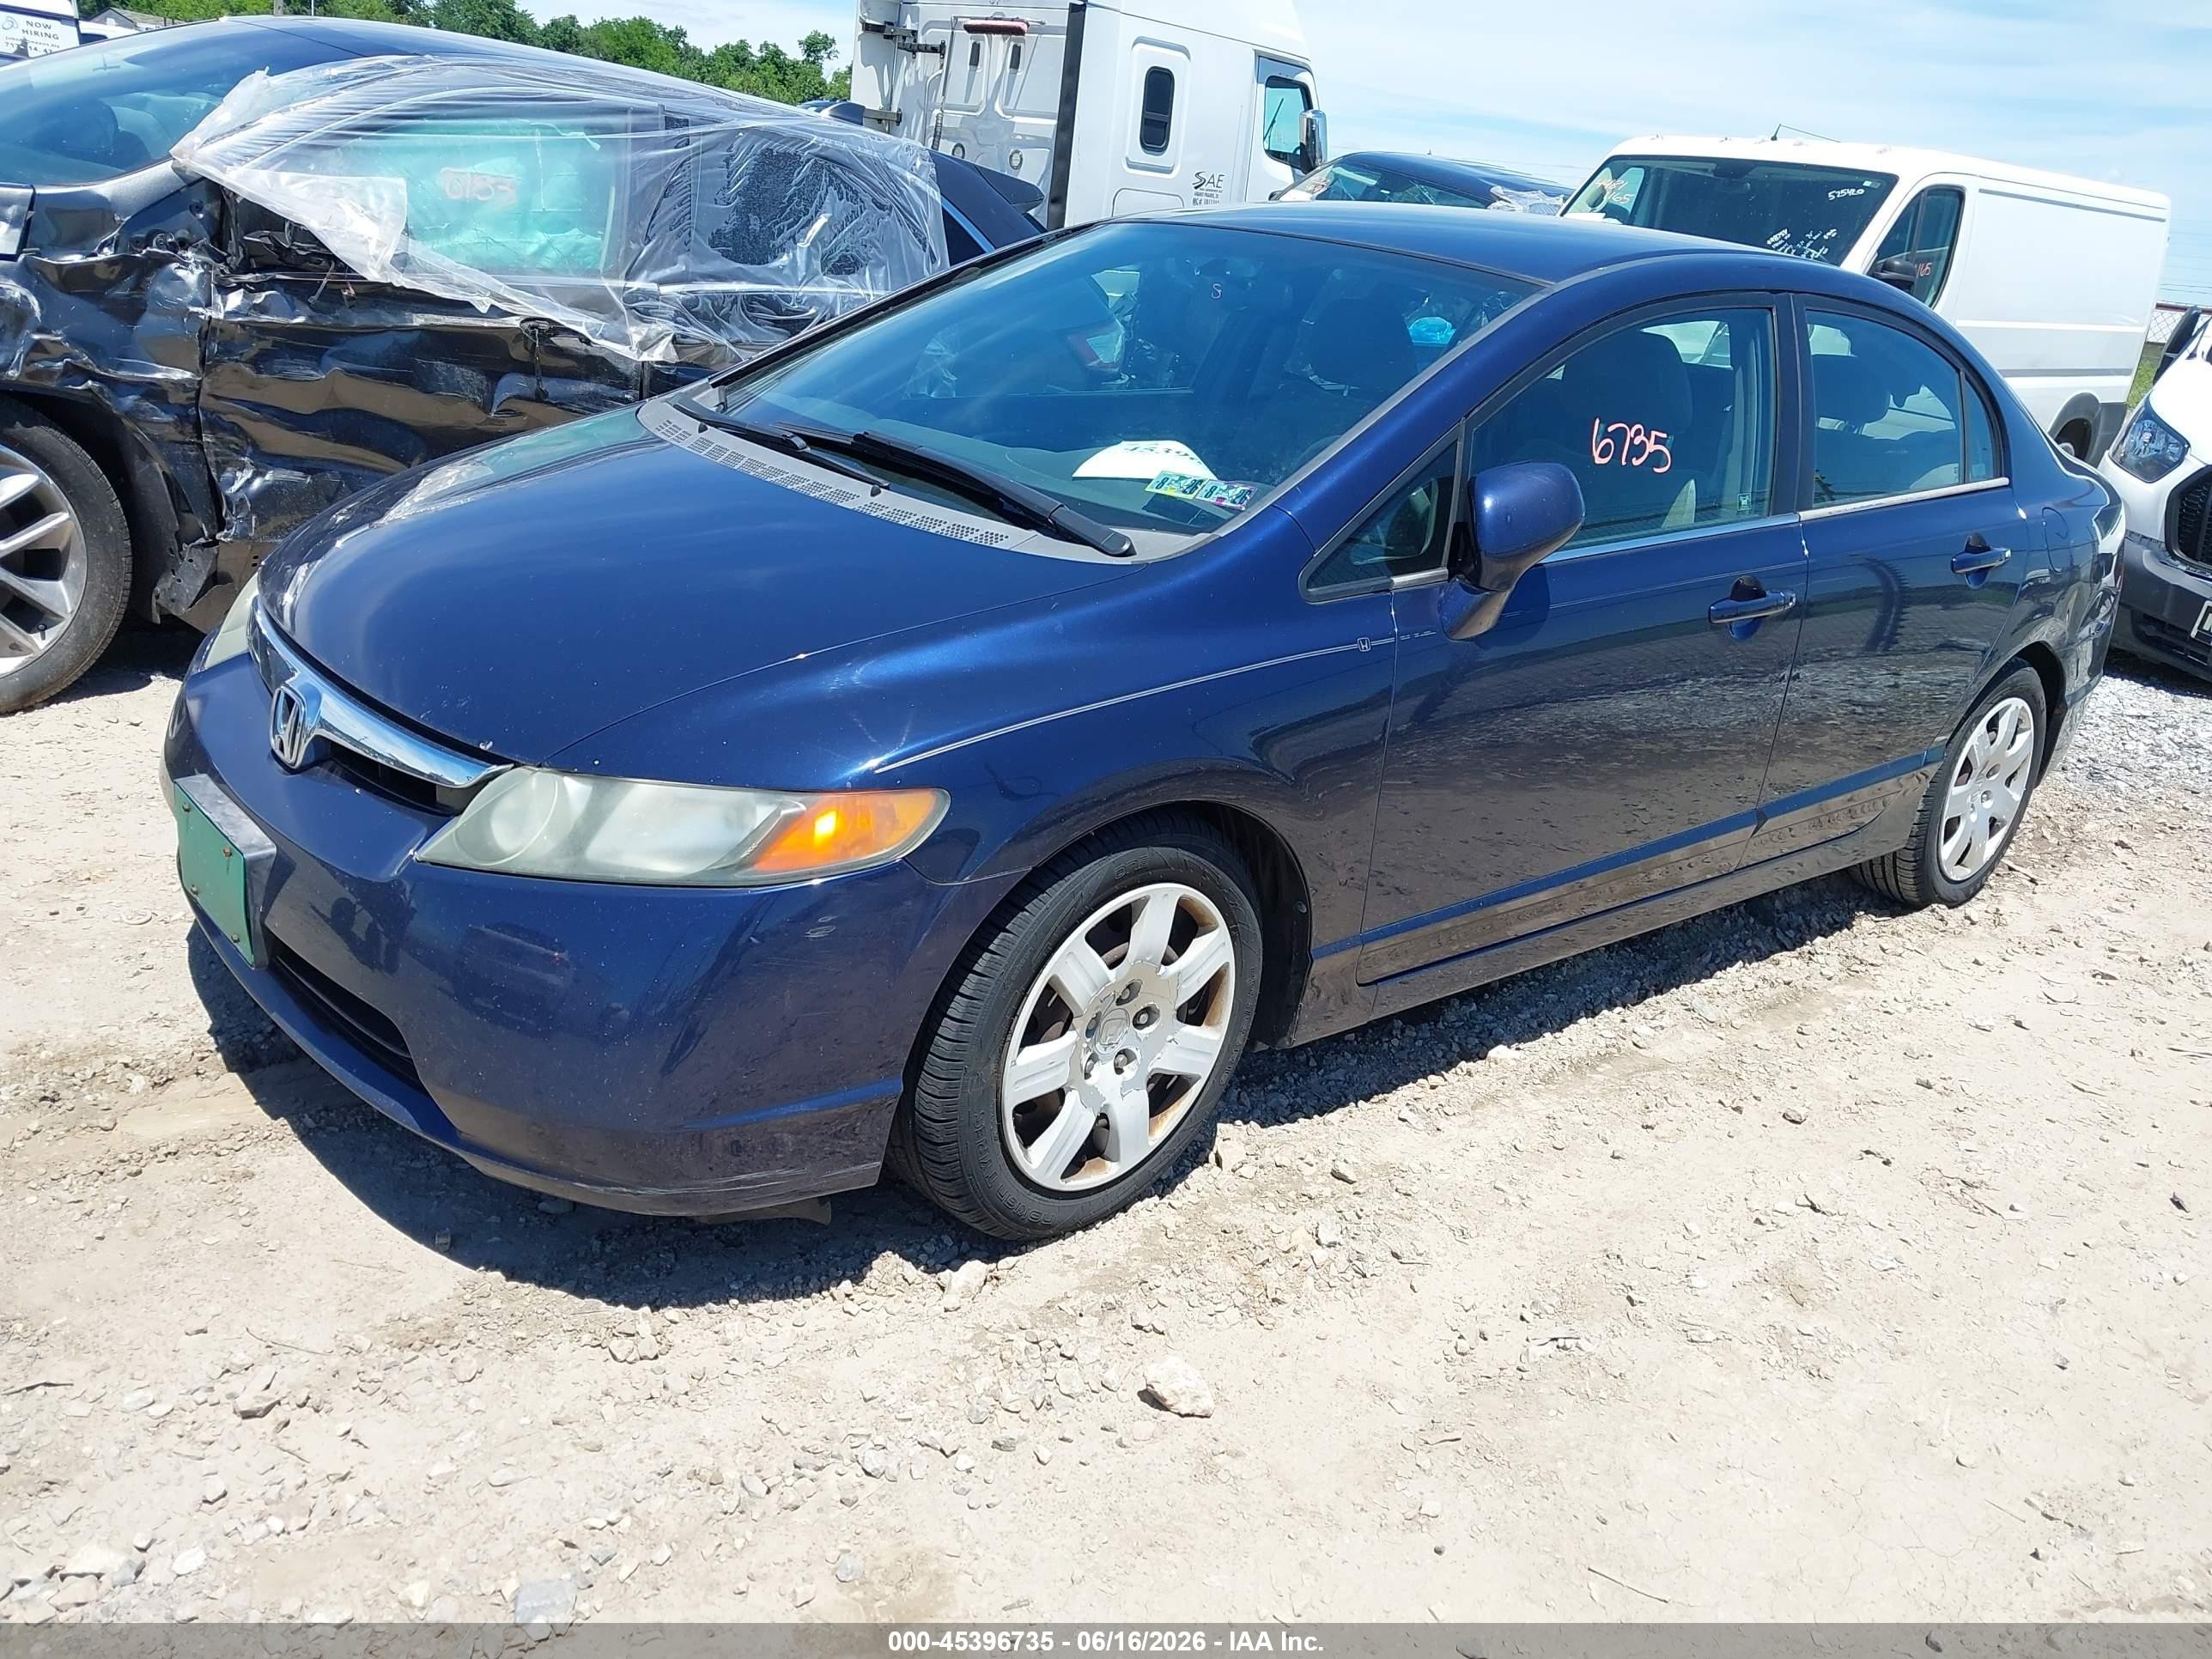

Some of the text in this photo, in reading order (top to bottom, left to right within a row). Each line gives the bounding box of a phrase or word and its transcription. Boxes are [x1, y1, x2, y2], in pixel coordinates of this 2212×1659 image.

[25, 20, 52, 30] NOW
[21, 28, 60, 40] HIRING
[1192, 171, 1225, 190] SAE
[1915, 262, 1932, 279] 165
[1592, 417, 1672, 473] 6735
[1155, 477, 1170, 490] 8
[1204, 485, 1218, 499] 8
